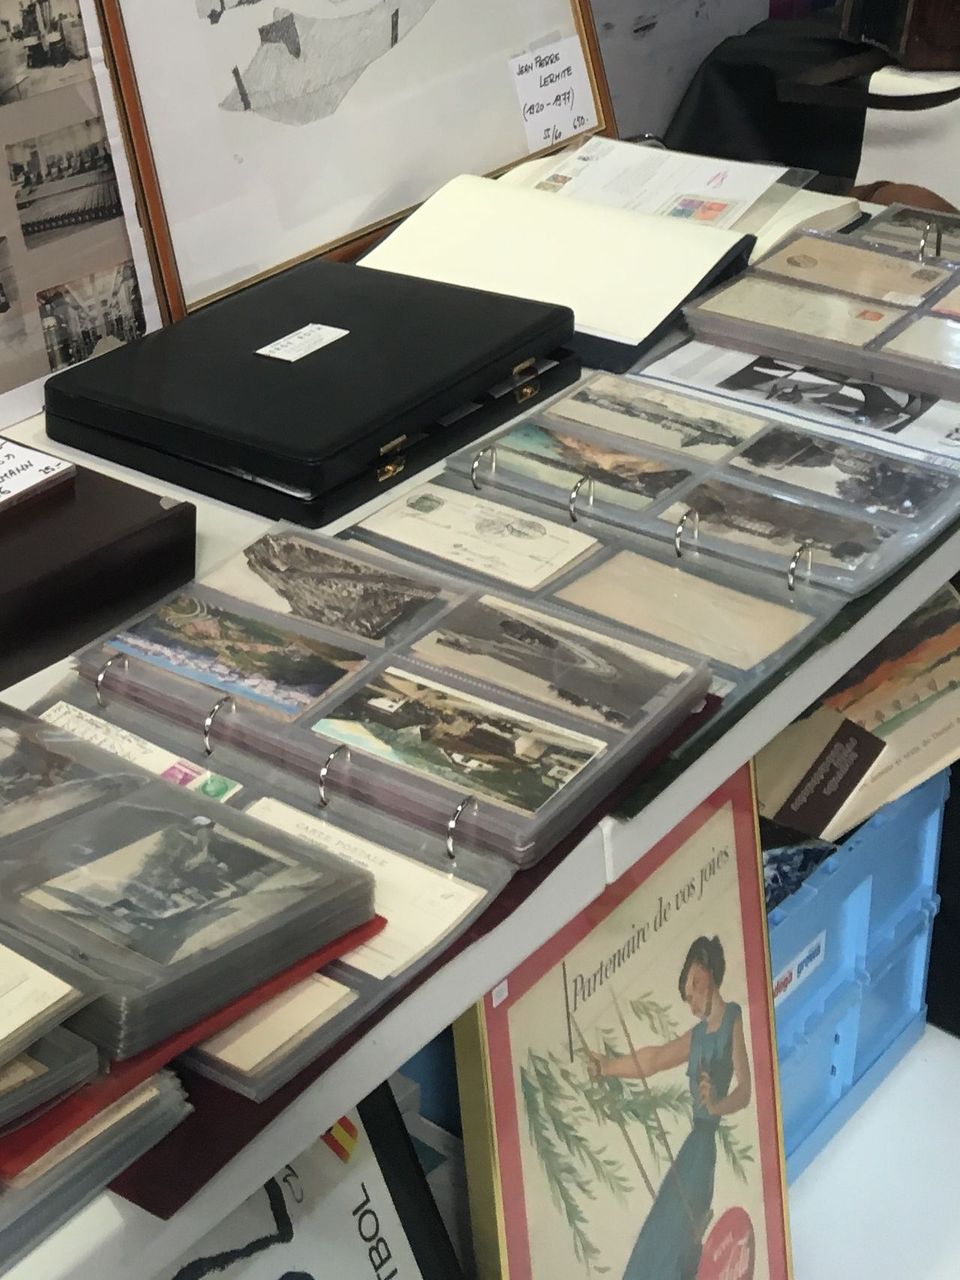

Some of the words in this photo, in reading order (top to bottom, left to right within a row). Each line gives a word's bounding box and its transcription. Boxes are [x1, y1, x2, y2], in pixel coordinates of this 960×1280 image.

[539, 66, 573, 88] LERMITE
[572, 922, 650, 1012] Partenaire
[653, 895, 672, 932] de
[675, 877, 696, 911] vos
[697, 845, 730, 900] joies
